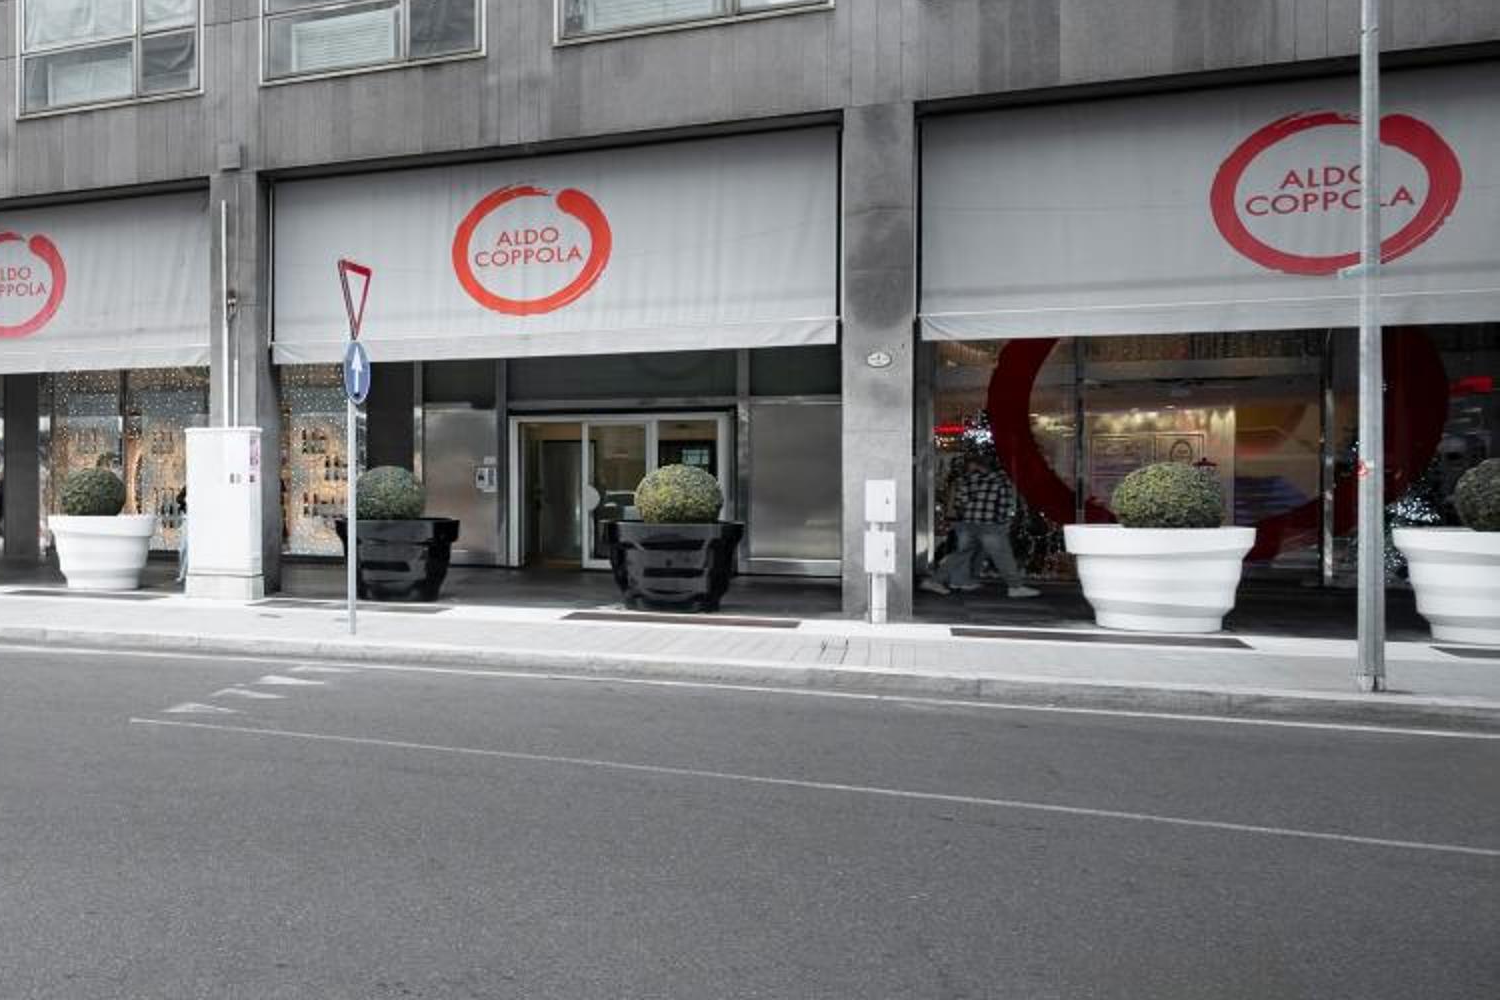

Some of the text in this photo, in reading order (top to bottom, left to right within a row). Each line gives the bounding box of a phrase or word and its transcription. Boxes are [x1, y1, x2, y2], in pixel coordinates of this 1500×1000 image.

[1245, 185, 1416, 217] COPPOA
[497, 226, 560, 248] ALDO
[475, 244, 583, 268] COPPOLA
